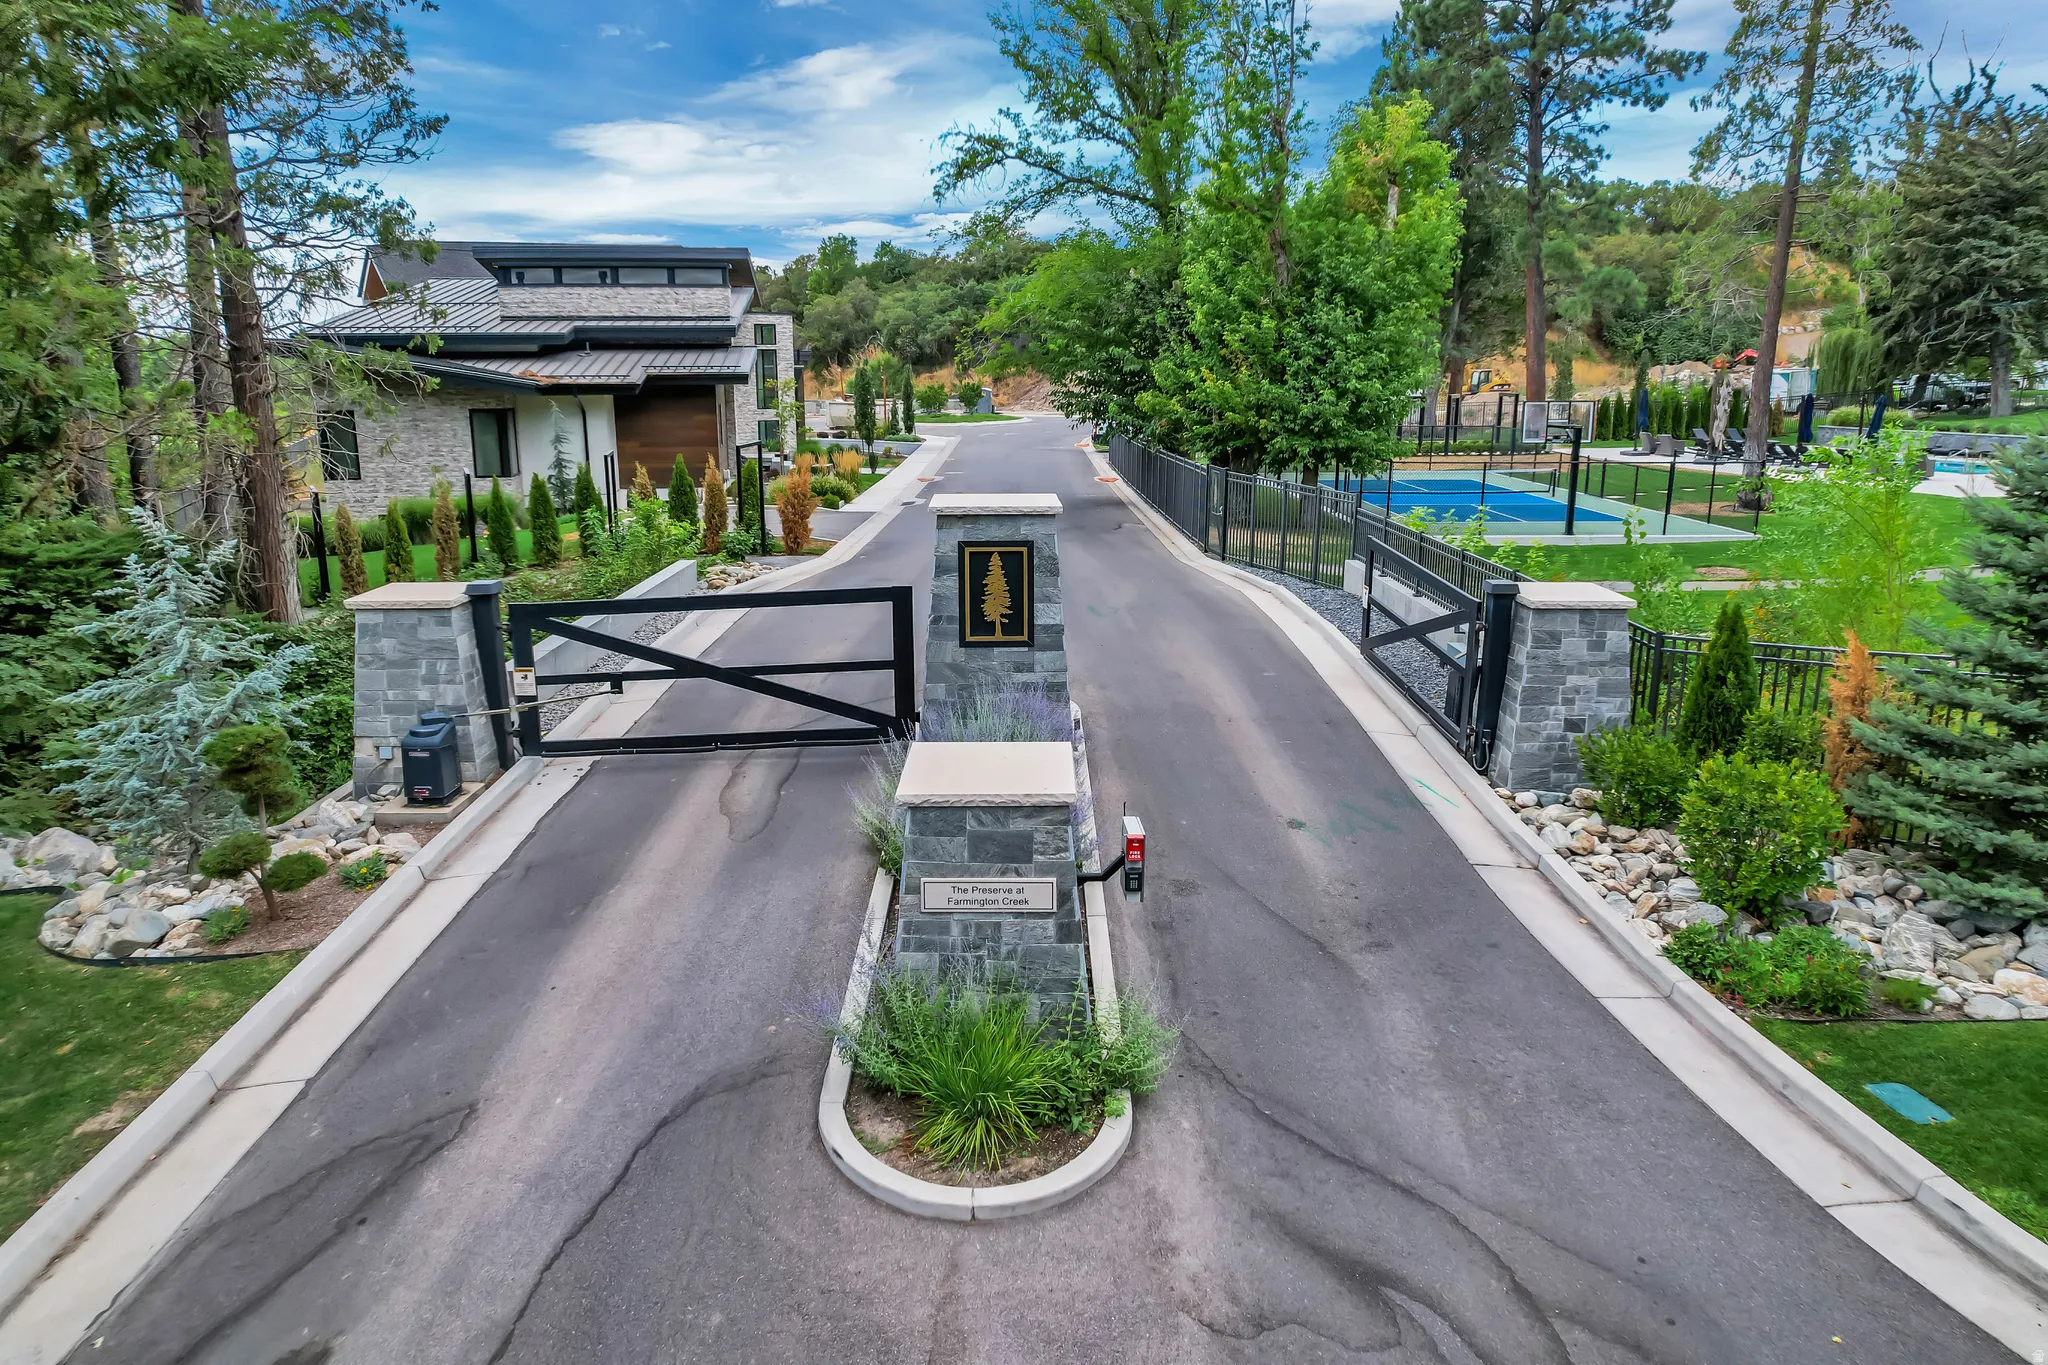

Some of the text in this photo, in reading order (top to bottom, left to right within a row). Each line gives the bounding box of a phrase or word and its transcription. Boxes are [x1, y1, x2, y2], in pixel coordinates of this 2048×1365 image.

[951, 886, 1025, 894] The Preserve at
[947, 897, 1030, 907] Farmington Creek
